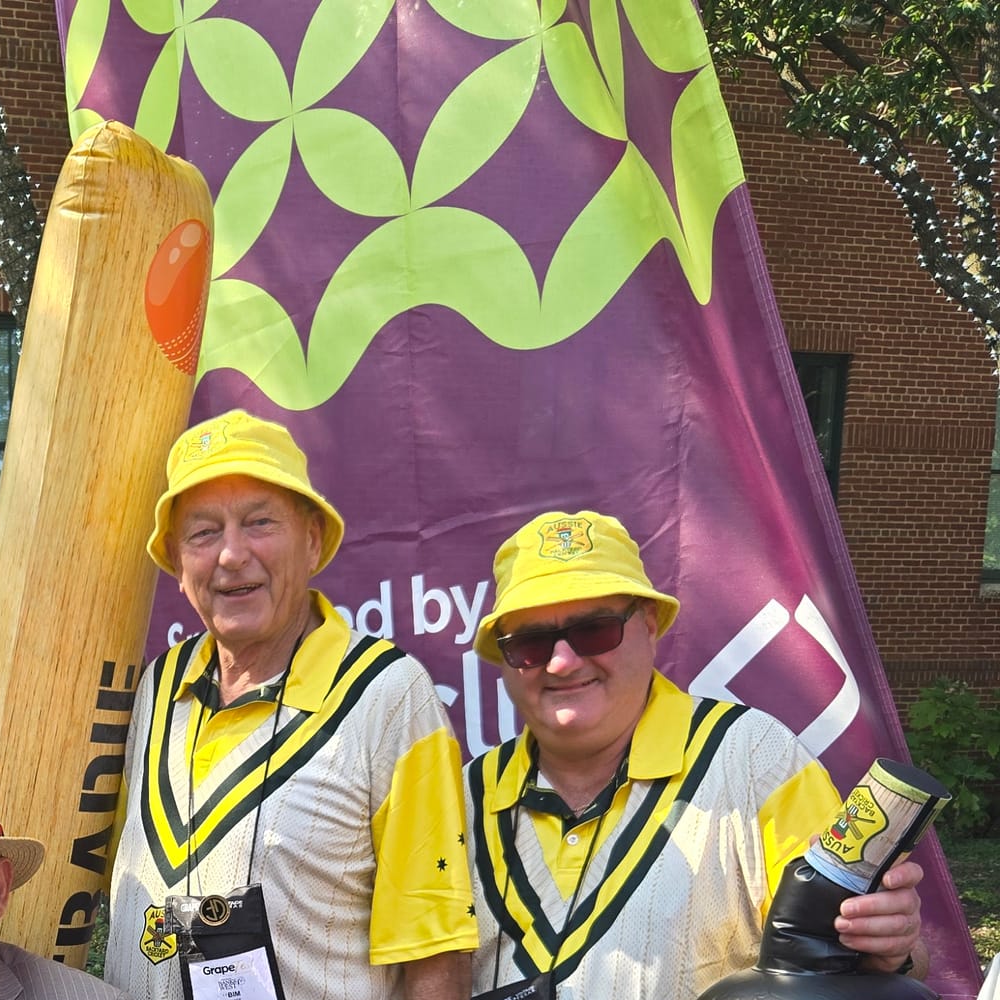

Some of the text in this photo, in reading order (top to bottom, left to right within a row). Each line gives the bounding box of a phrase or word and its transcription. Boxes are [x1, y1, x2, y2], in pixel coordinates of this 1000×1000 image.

[411, 574, 489, 645] by
[52, 660, 137, 964] RADIE
[822, 827, 855, 854] AUSS
